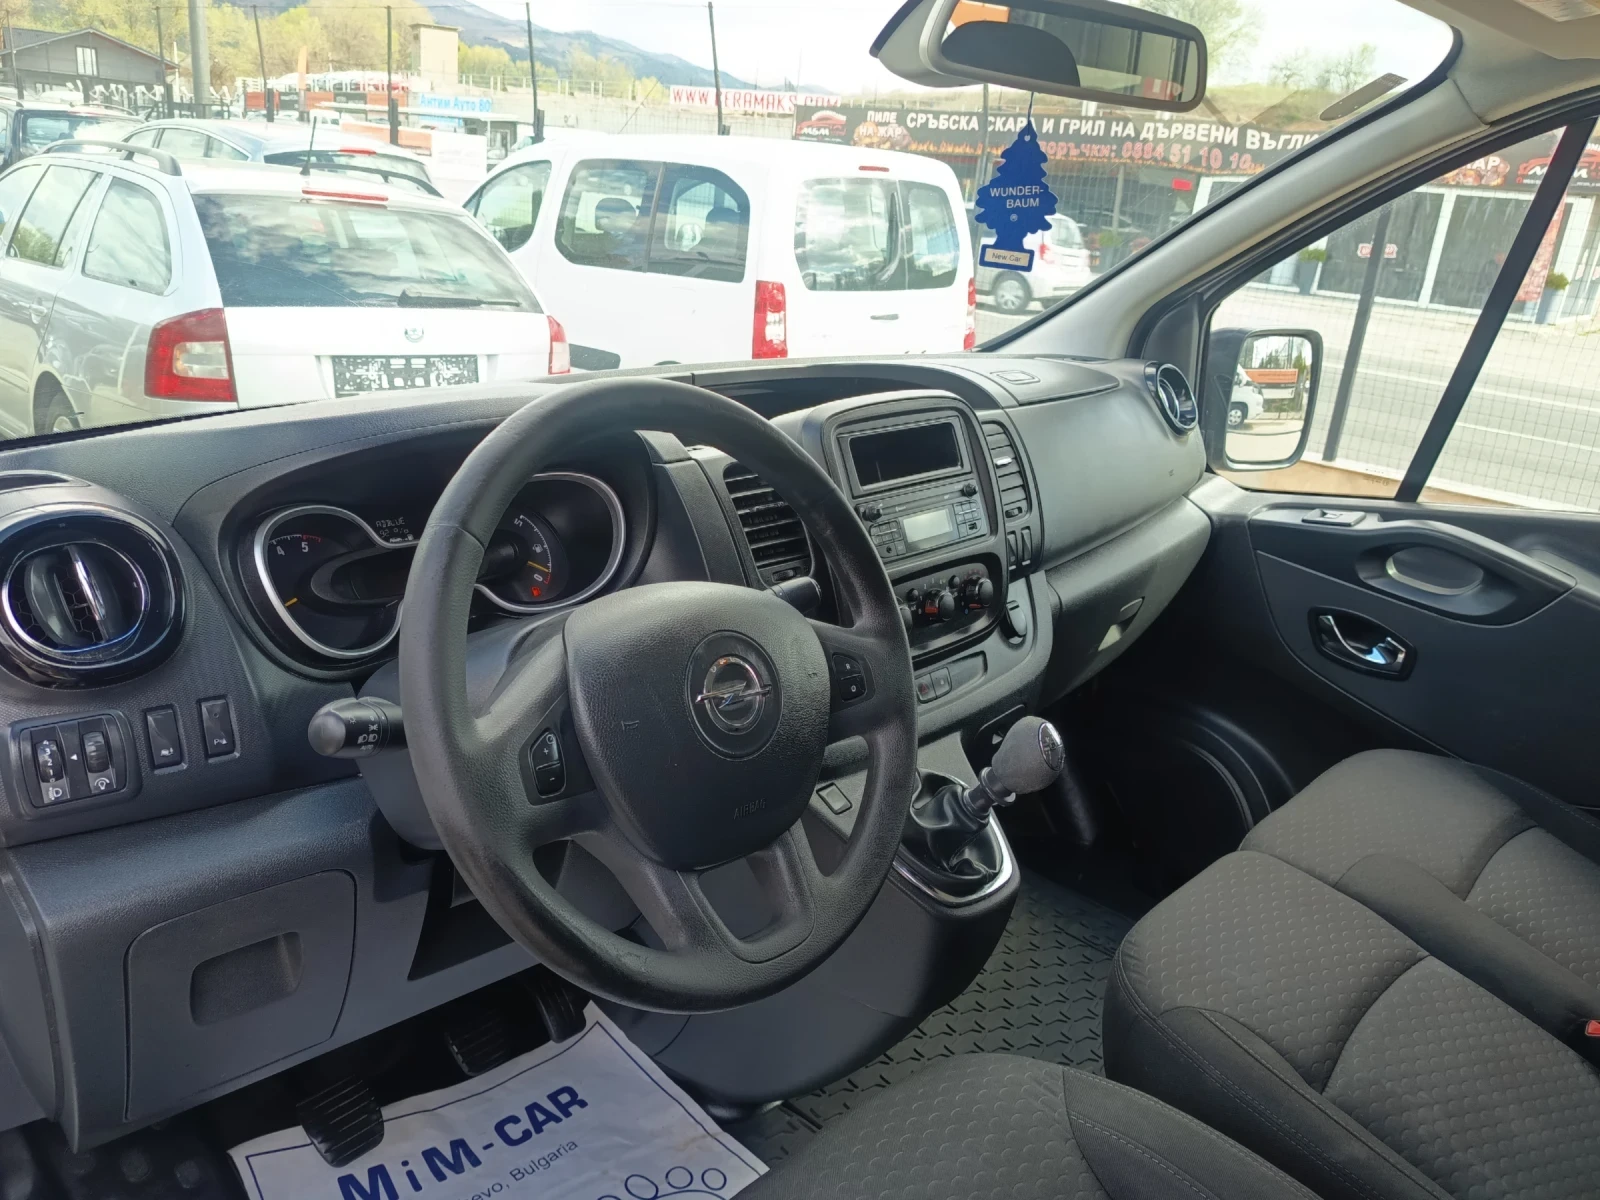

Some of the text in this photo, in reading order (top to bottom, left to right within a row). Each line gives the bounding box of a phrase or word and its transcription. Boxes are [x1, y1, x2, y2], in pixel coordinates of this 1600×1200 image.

[867, 110, 898, 124] ПИЛЕ
[860, 125, 903, 138] НА ЖАР
[906, 112, 979, 131] СРЪБСКА
[1041, 117, 1055, 134] И
[1059, 118, 1105, 137] ГРИЛ
[1110, 121, 1135, 138] НА
[1140, 121, 1240, 147] ДЪРВЕНИ
[1169, 143, 1191, 164] 51
[1199, 146, 1223, 169] 10
[1230, 152, 1252, 170] 10
[989, 185, 1044, 197] WUNDER-
[1006, 198, 1040, 209] BAUM
[991, 253, 1022, 263] New Car
[276, 545, 286, 556] 4
[301, 541, 309, 552] 5
[533, 573, 544, 582] 0
[337, 1085, 589, 1200] MiM-CAR
[509, 1141, 578, 1181] Bulgaria
